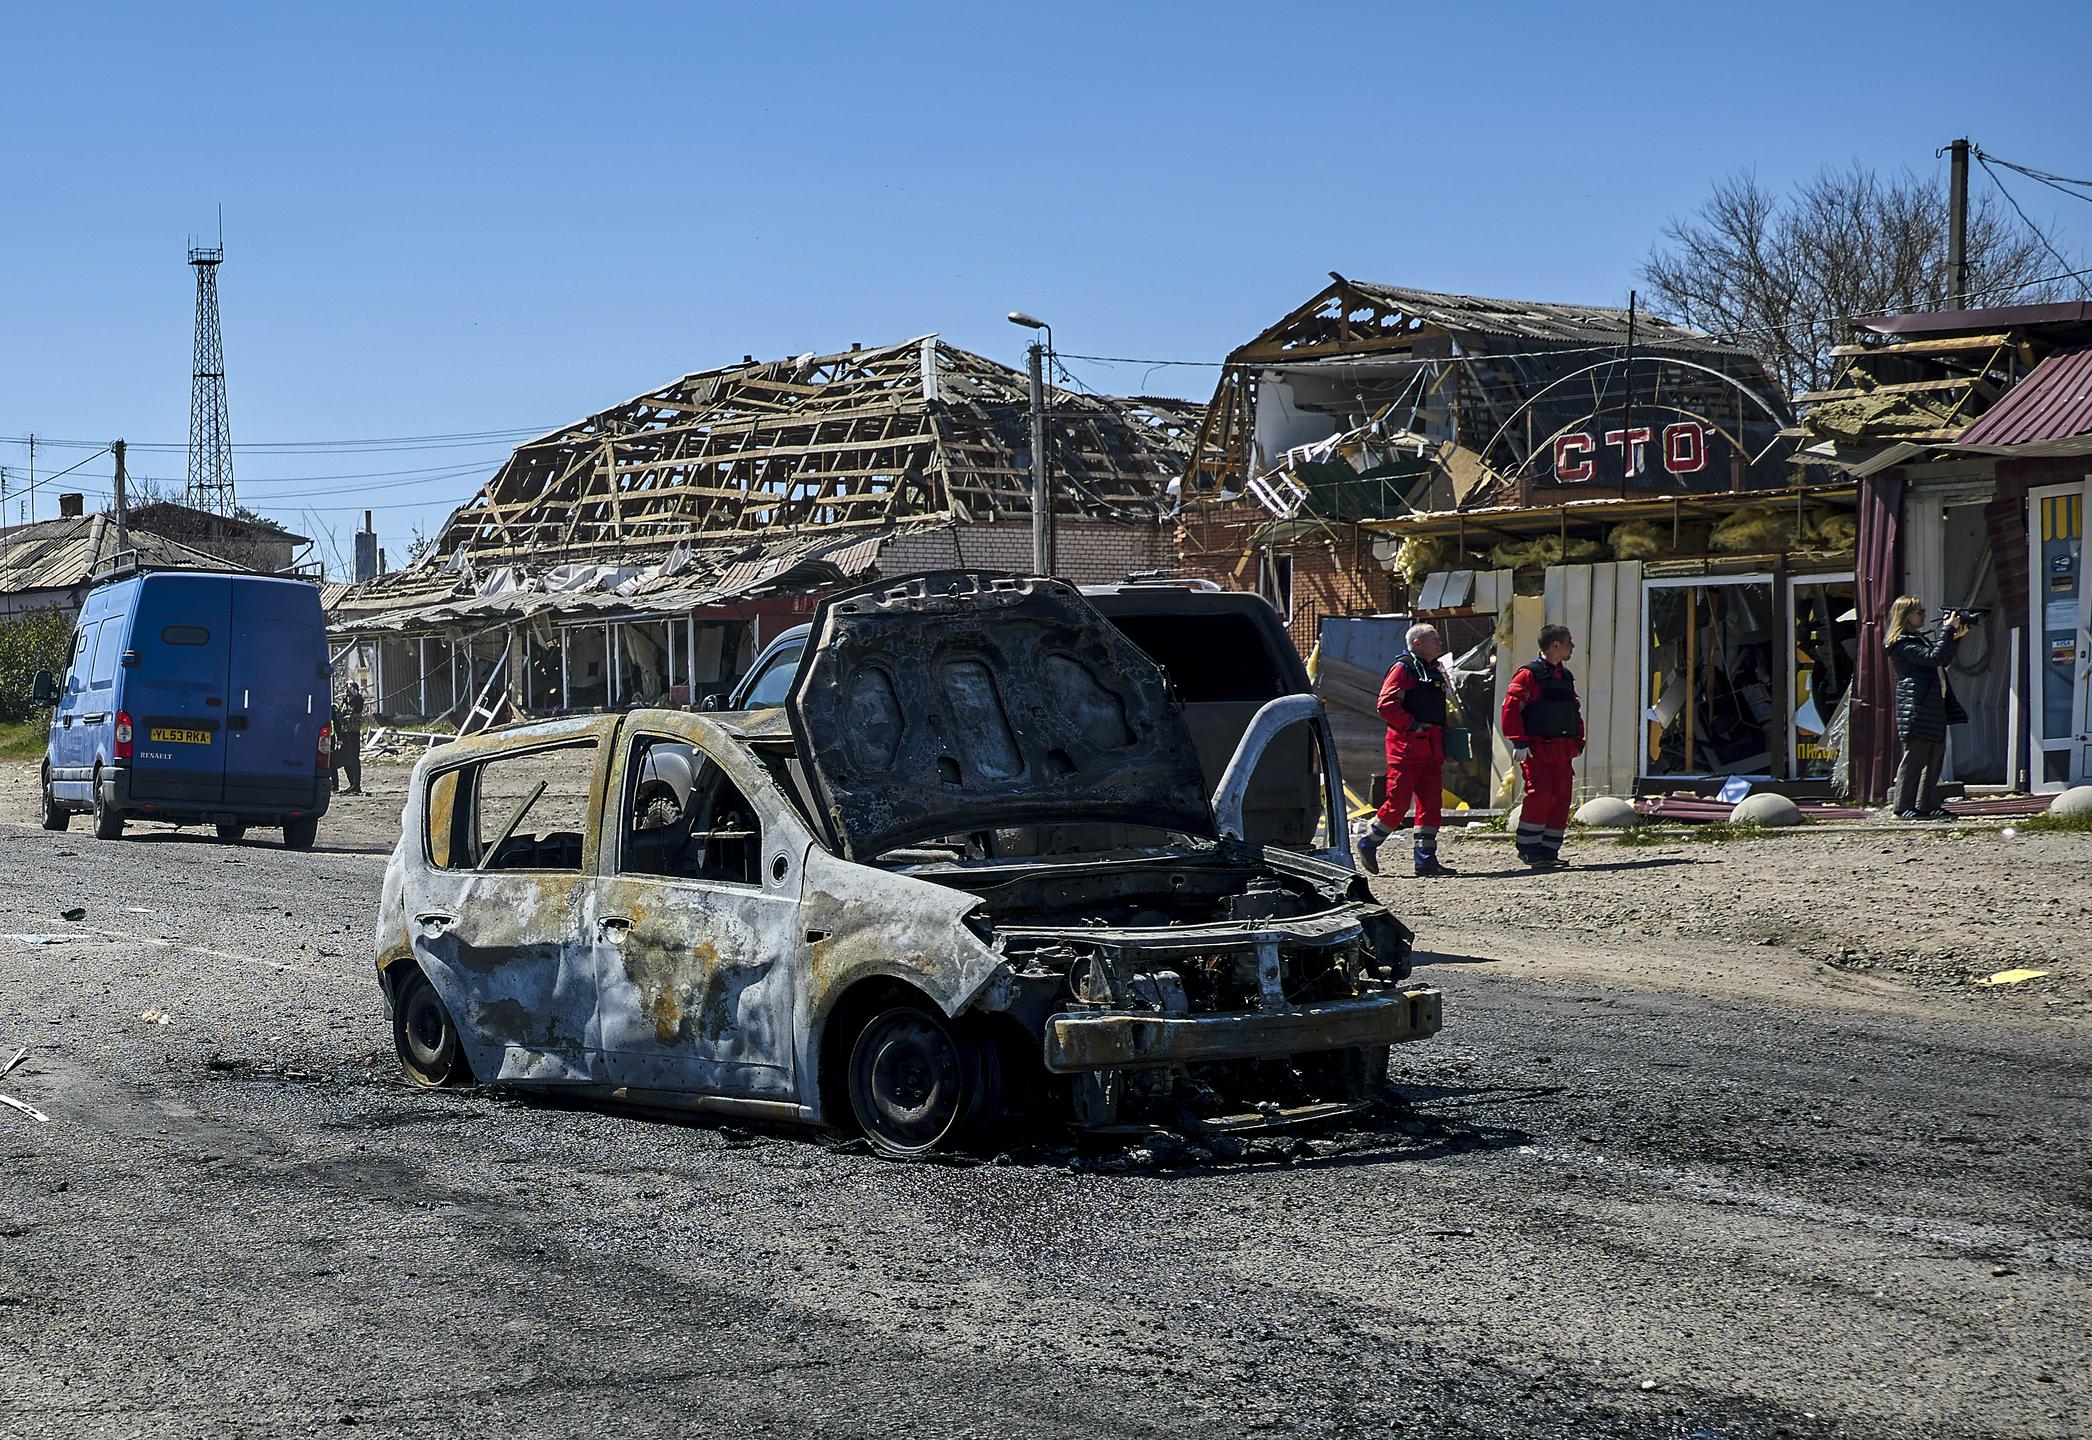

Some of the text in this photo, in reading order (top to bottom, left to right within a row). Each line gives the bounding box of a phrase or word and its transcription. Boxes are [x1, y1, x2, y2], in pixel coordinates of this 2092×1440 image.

[1554, 422, 1707, 483] СТО
[156, 730, 206, 742] YL53 RKA
